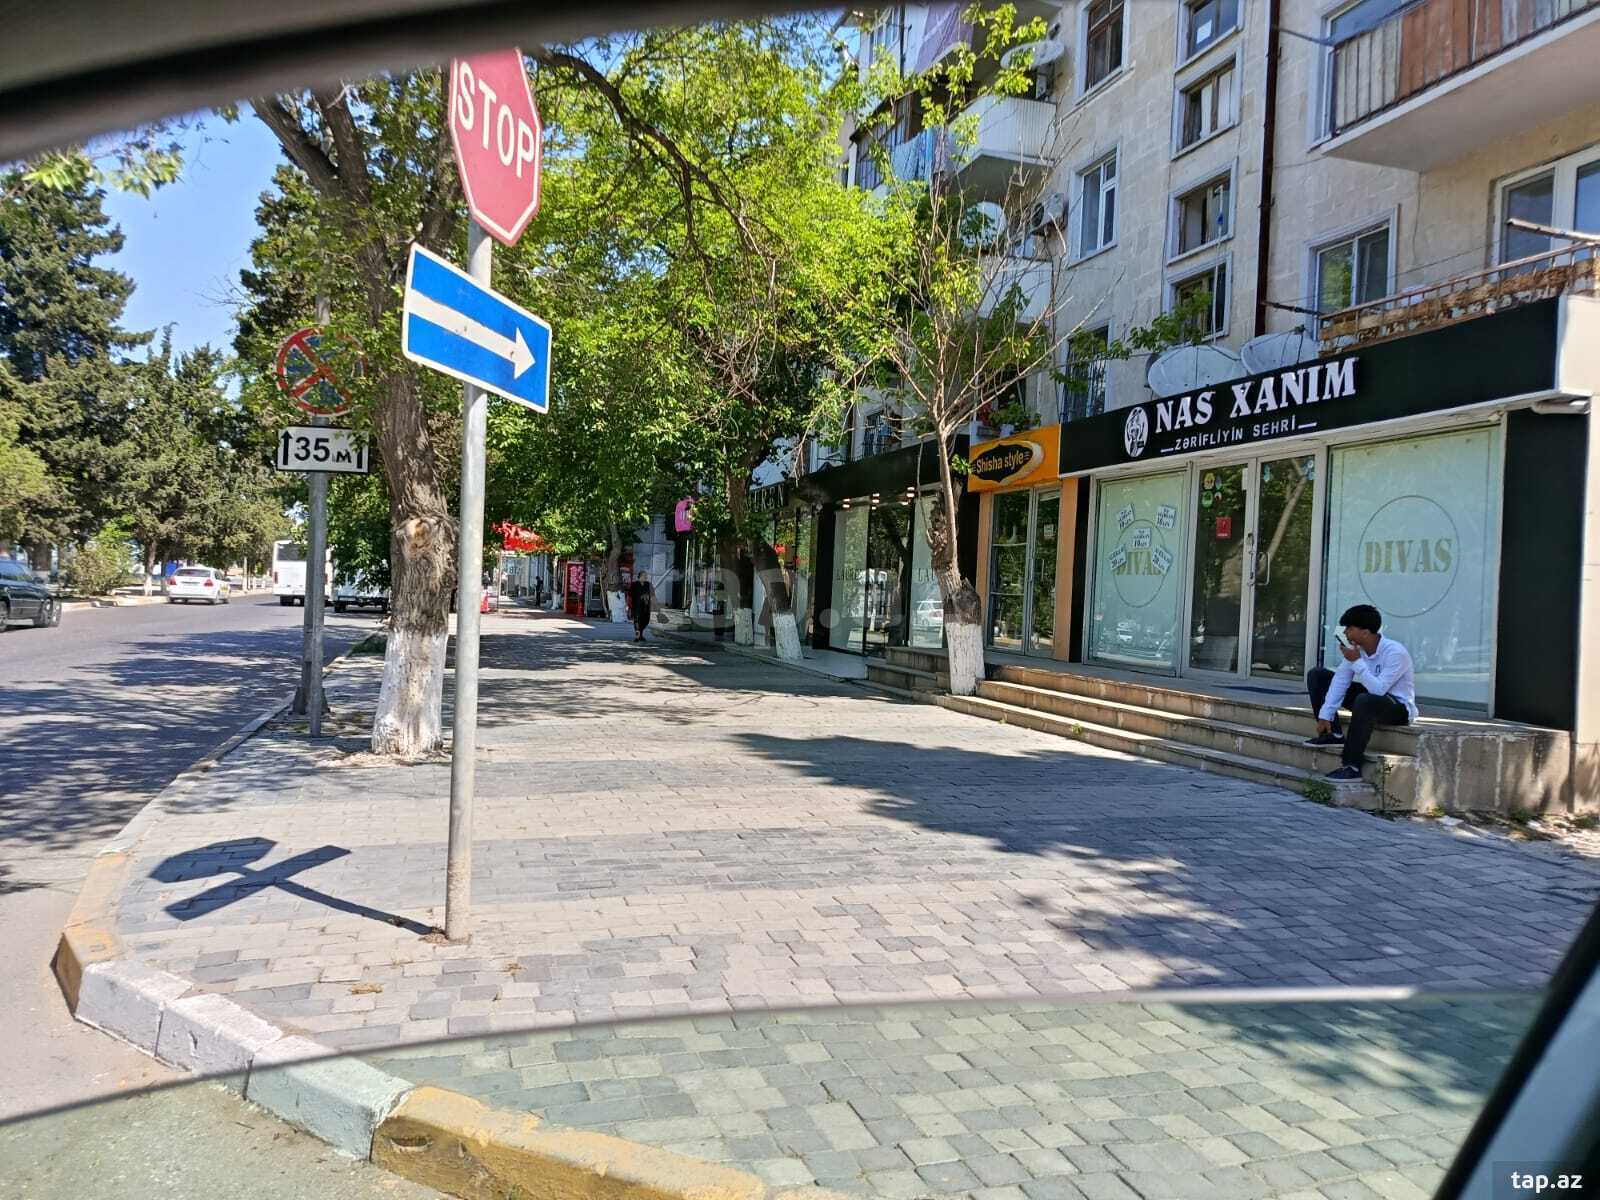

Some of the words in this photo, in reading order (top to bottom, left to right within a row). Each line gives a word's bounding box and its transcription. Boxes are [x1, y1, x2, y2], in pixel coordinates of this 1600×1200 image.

[458, 62, 534, 177] STOP
[1155, 395, 1216, 434] NAS
[1230, 358, 1357, 418] XANIM
[1252, 416, 1297, 438] SEHRİ
[294, 437, 330, 461] 35
[976, 457, 1003, 483] Shisha
[1004, 450, 1024, 471] style
[1364, 538, 1453, 573] DIVAS
